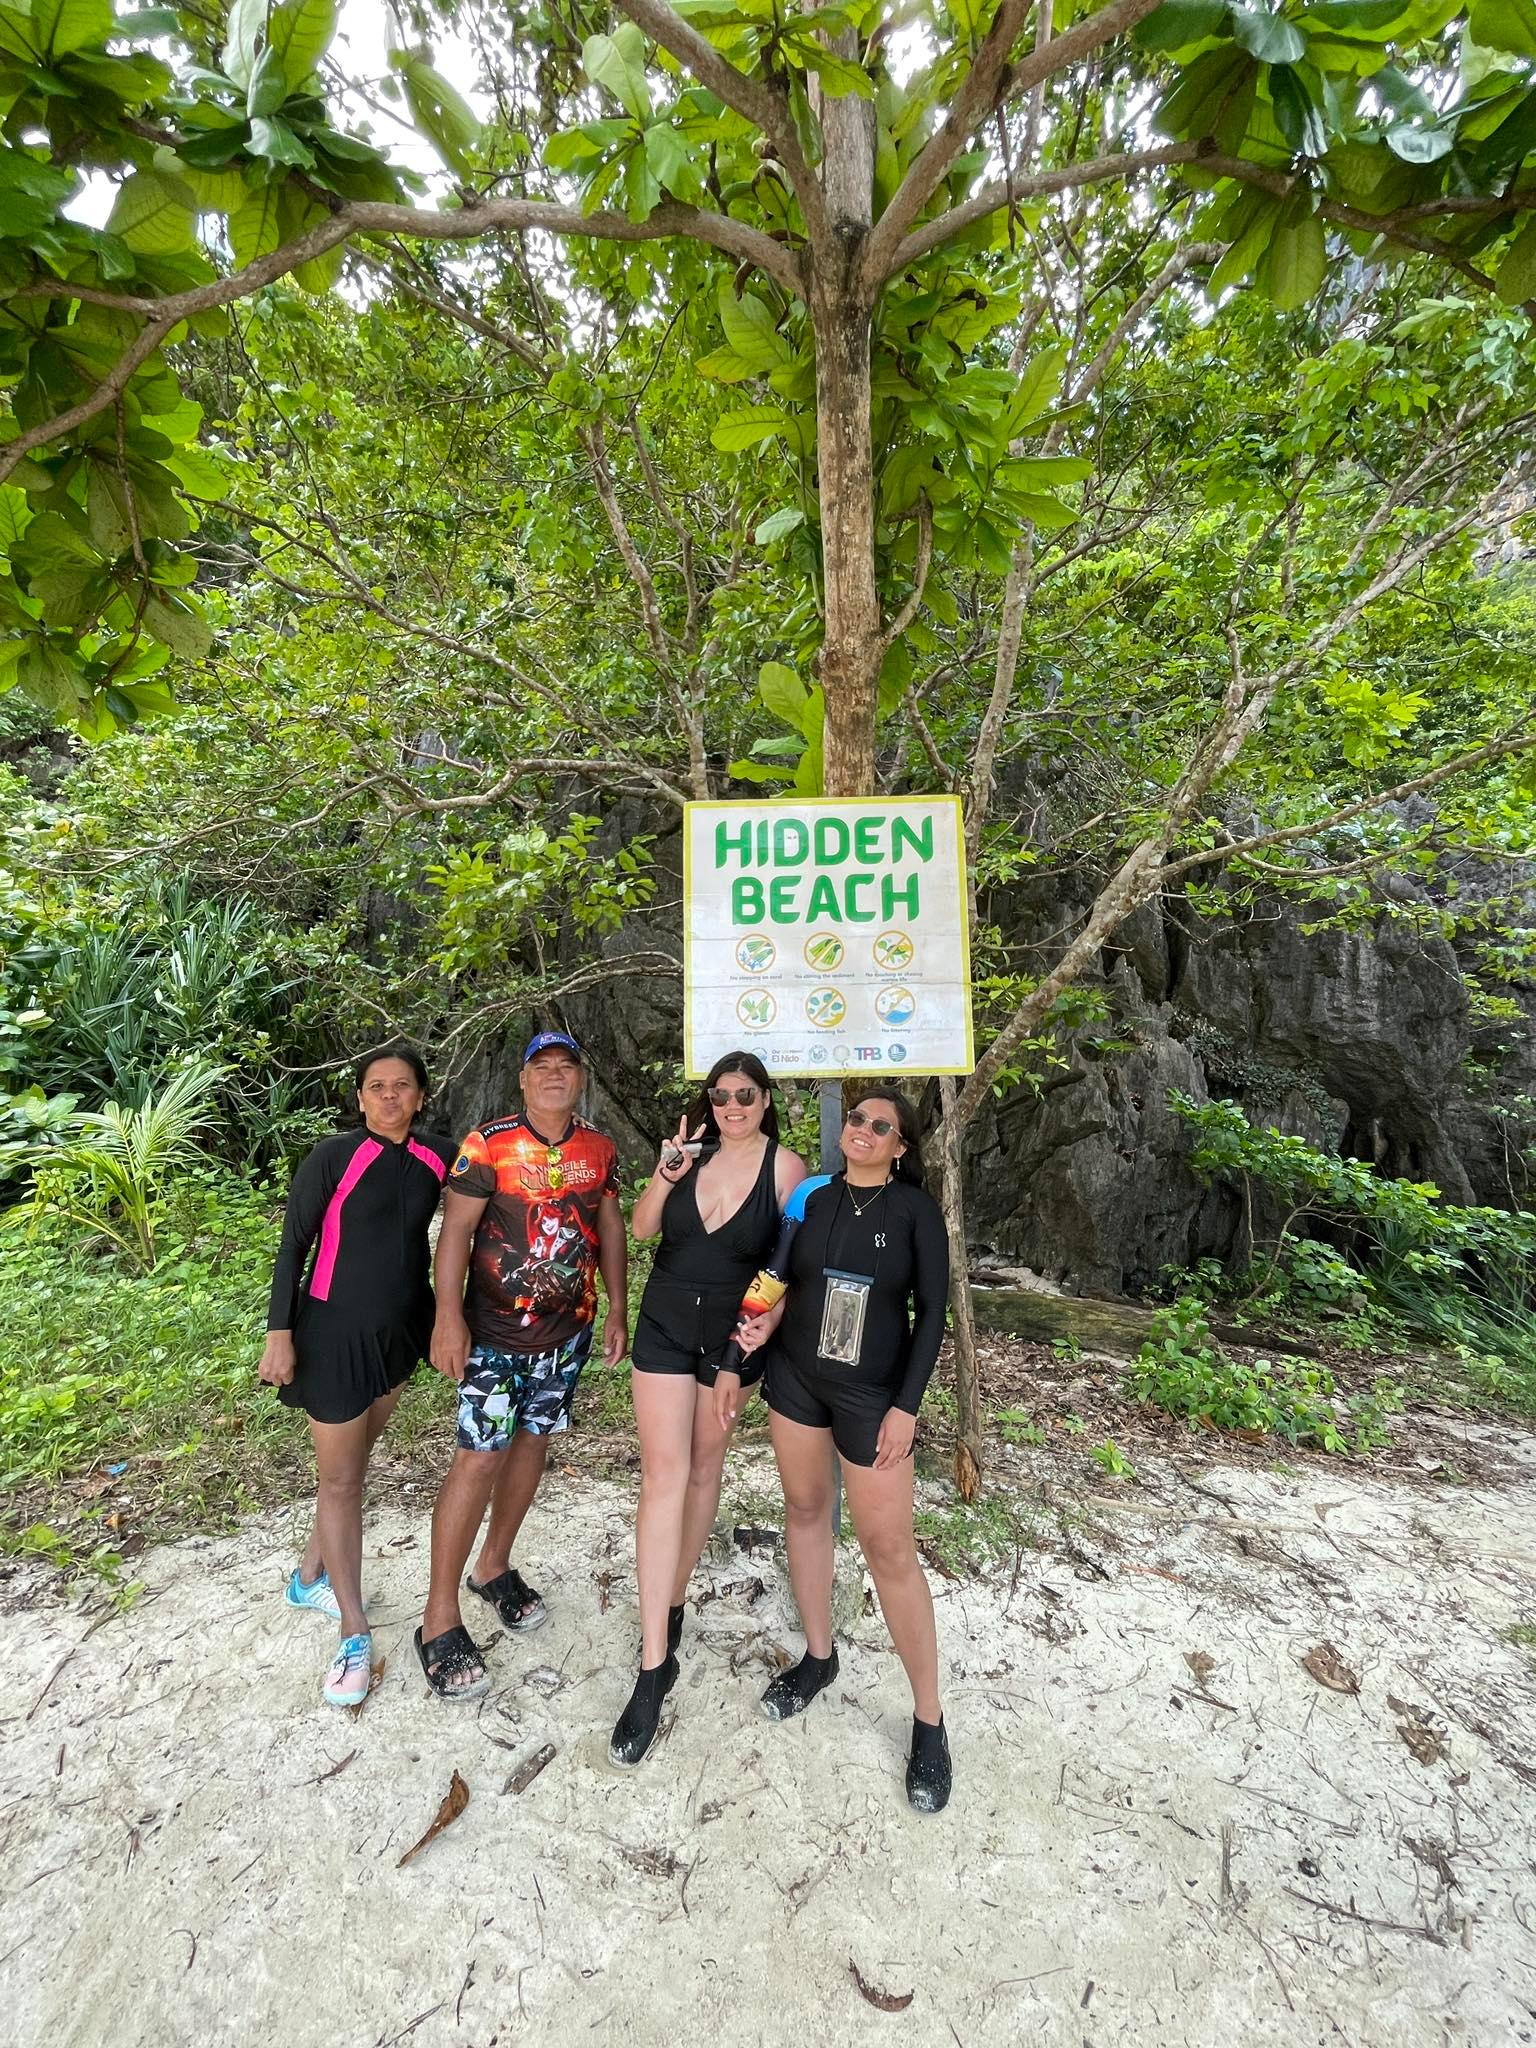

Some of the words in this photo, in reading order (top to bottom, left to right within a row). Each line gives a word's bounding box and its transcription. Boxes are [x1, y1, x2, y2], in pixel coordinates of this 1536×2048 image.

[715, 815, 934, 869] HIDDEN
[731, 872, 920, 926] BEACH
[781, 1054, 800, 1063] Nido
[854, 1046, 882, 1061] TPB
[483, 1121, 519, 1136] HYBREED
